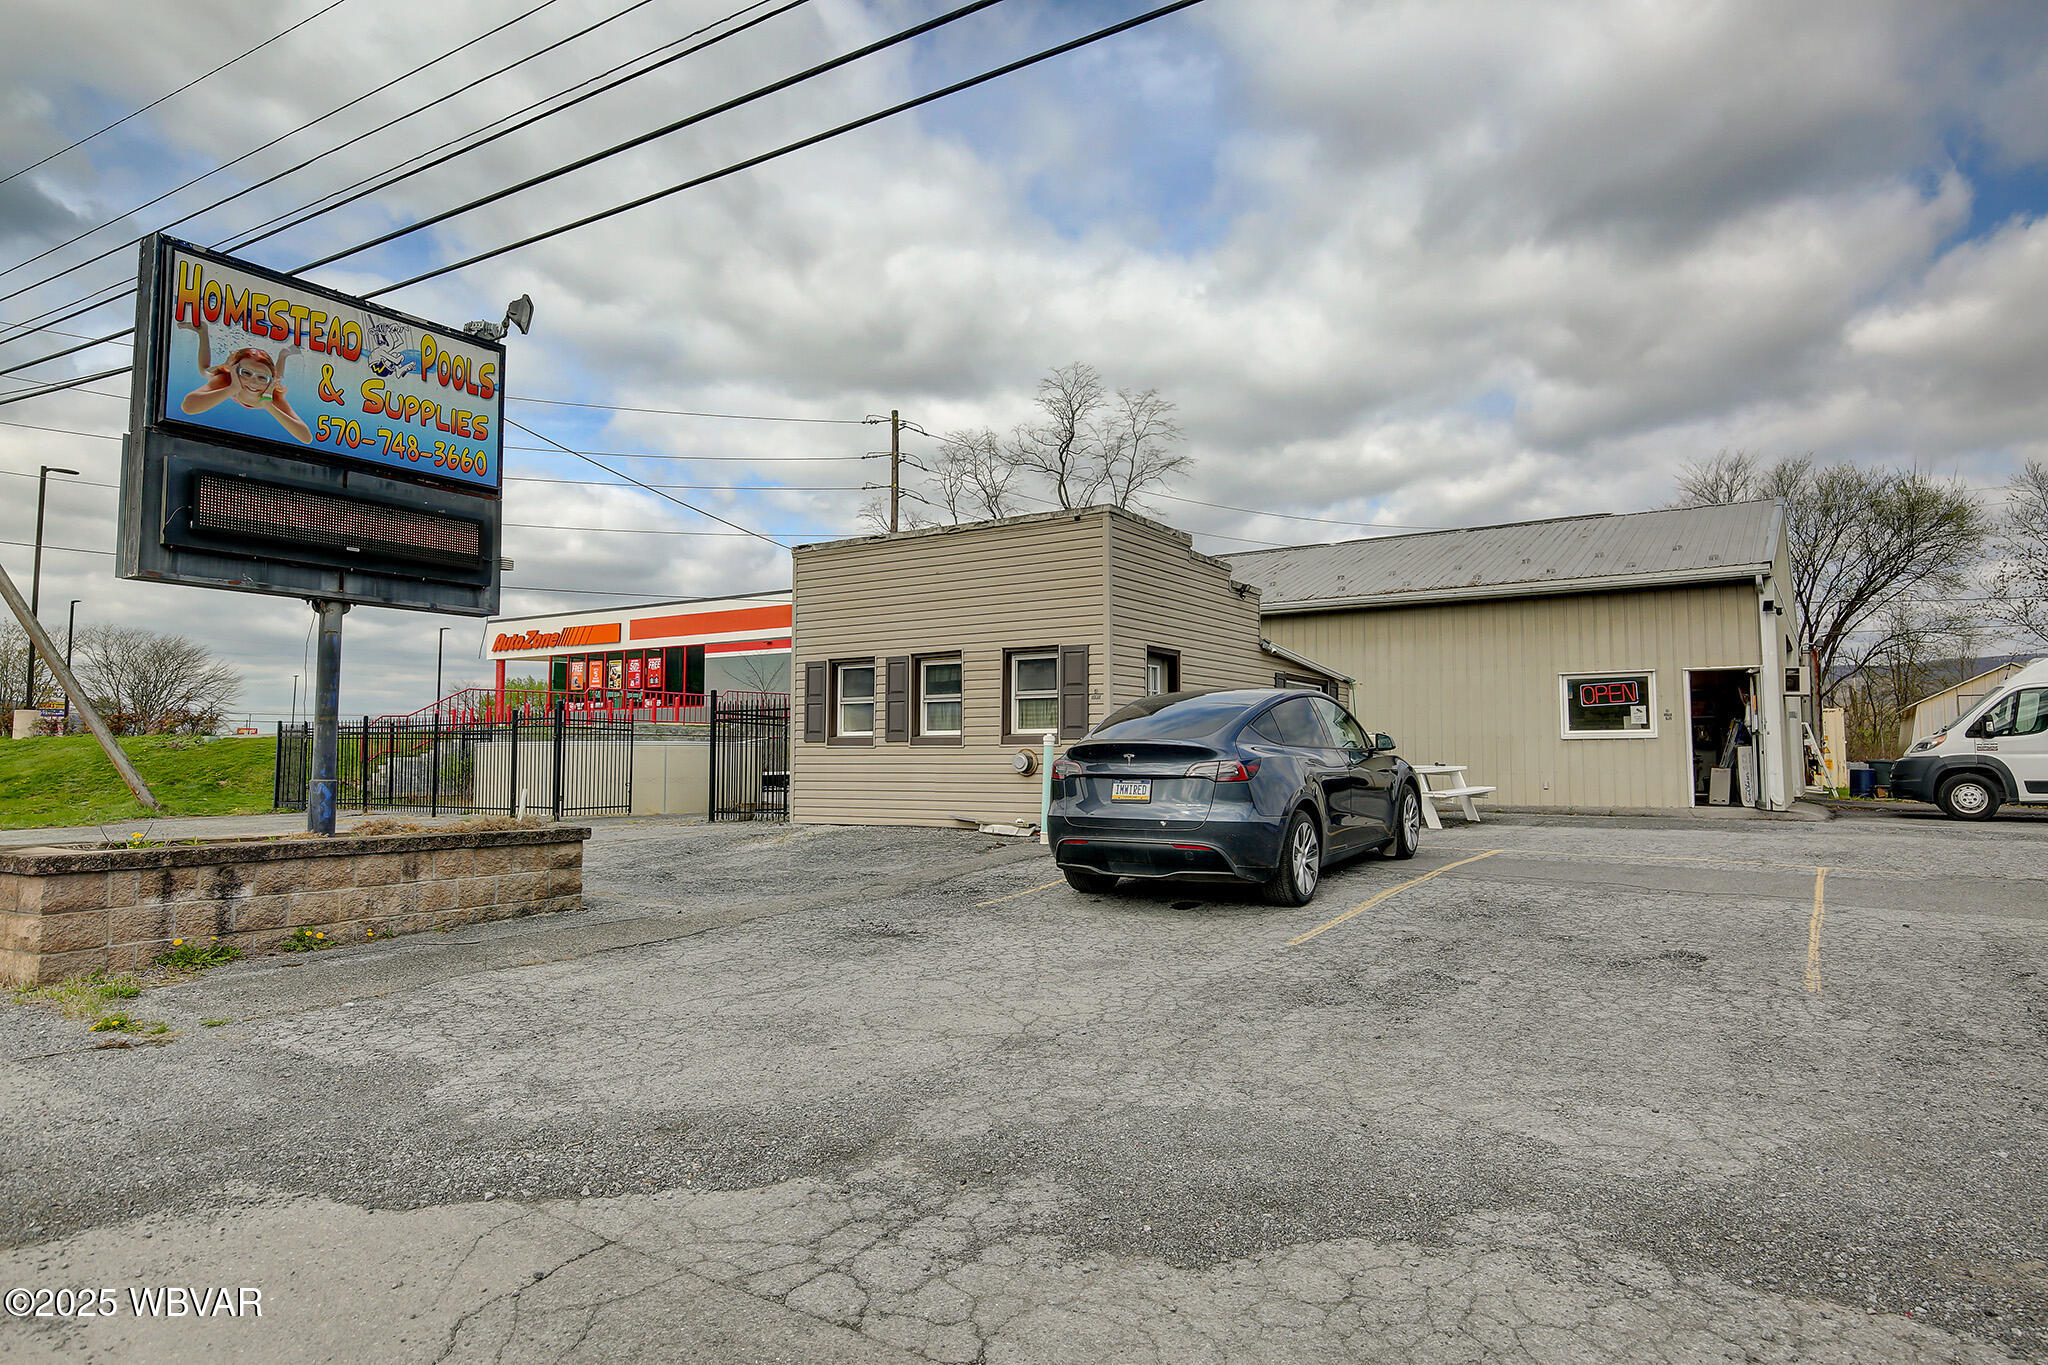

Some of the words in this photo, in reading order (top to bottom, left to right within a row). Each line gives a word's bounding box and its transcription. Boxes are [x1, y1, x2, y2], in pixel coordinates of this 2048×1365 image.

[175, 260, 362, 362] HOMESTEAD
[420, 334, 496, 400] POOLS
[317, 363, 345, 406] &
[360, 378, 489, 442] SUPPLIES
[315, 415, 488, 477] 570-748-3660
[491, 629, 560, 652] AutoZone
[1582, 683, 1636, 705] OPEN
